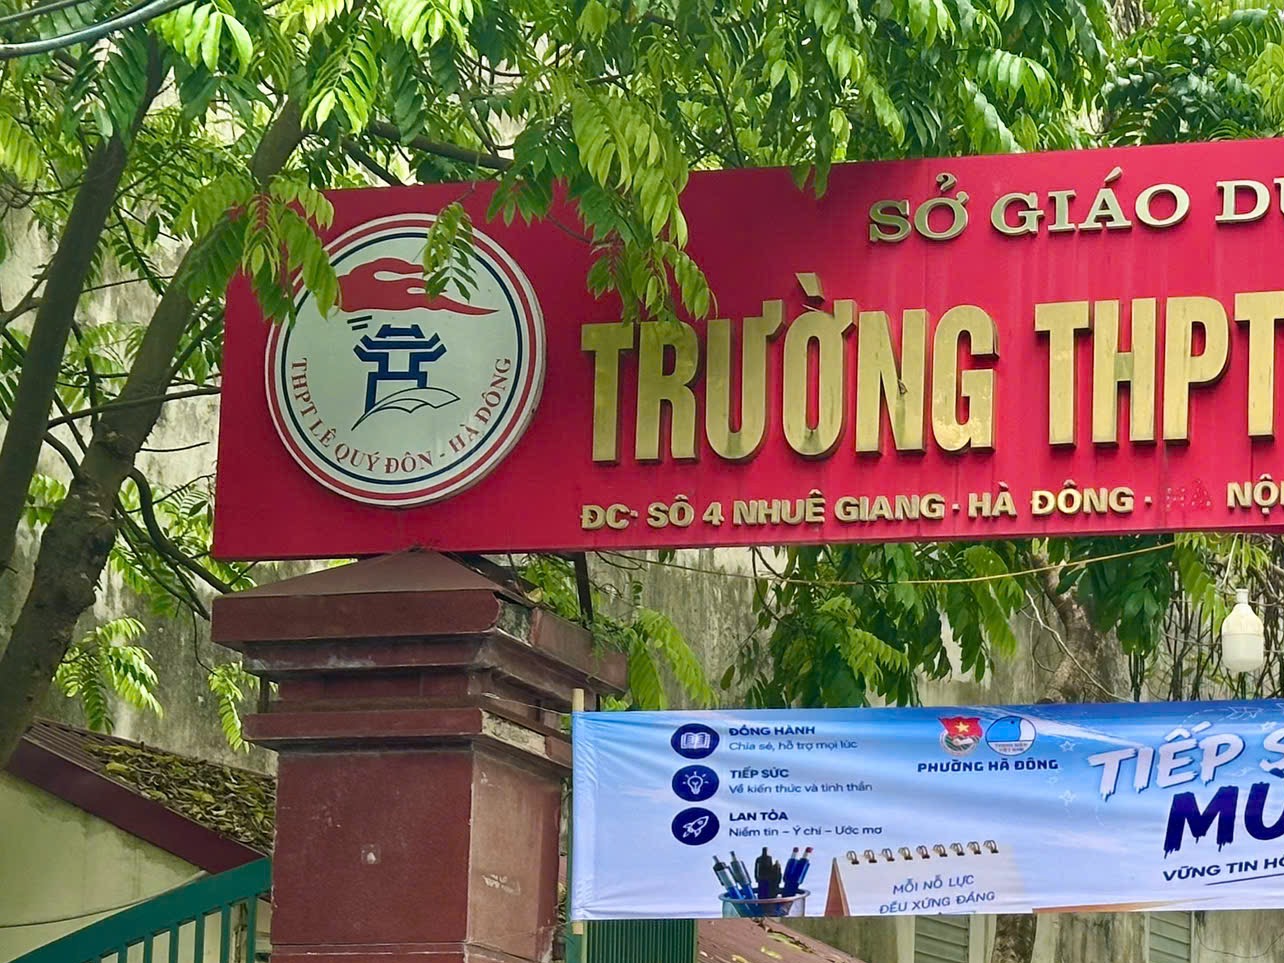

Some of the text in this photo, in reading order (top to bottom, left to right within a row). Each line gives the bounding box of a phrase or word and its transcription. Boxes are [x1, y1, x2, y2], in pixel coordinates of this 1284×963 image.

[868, 173, 970, 244] SỞ
[990, 166, 1191, 237] GIÁO
[580, 272, 998, 463] TRƯỜNG
[290, 356, 318, 417] THPT
[308, 418, 337, 448] LÊ
[334, 443, 380, 473] QUÝ
[384, 451, 434, 474] ĐÔN
[447, 423, 480, 454] HÀ
[474, 357, 512, 425] ĐÔNG
[702, 501, 725, 527] 4
[833, 493, 946, 523] GIANG
[967, 481, 1018, 519] HÀ
[1030, 479, 1135, 516] ĐÔNG
[773, 725, 816, 736] HÀNH
[728, 741, 756, 751] Chia
[815, 740, 838, 751] mọi
[840, 739, 858, 749] lúc
[917, 756, 1059, 773] PHƯỜNG HÀ ĐÔNG
[1087, 721, 1246, 801] TIẾP
[730, 766, 790, 779] TIẾP SỨC
[804, 783, 818, 793] và
[821, 782, 843, 793] tinh
[729, 812, 757, 822] LAN
[763, 826, 779, 837] tin
[792, 824, 801, 836] Ý
[803, 825, 822, 836] chí
[862, 825, 883, 835] mơ
[1163, 864, 1221, 882] VỮNG
[1226, 860, 1258, 874] TIN
[892, 874, 975, 895] MỖI NỖ LỰC
[956, 891, 995, 905] ĐÁNG
